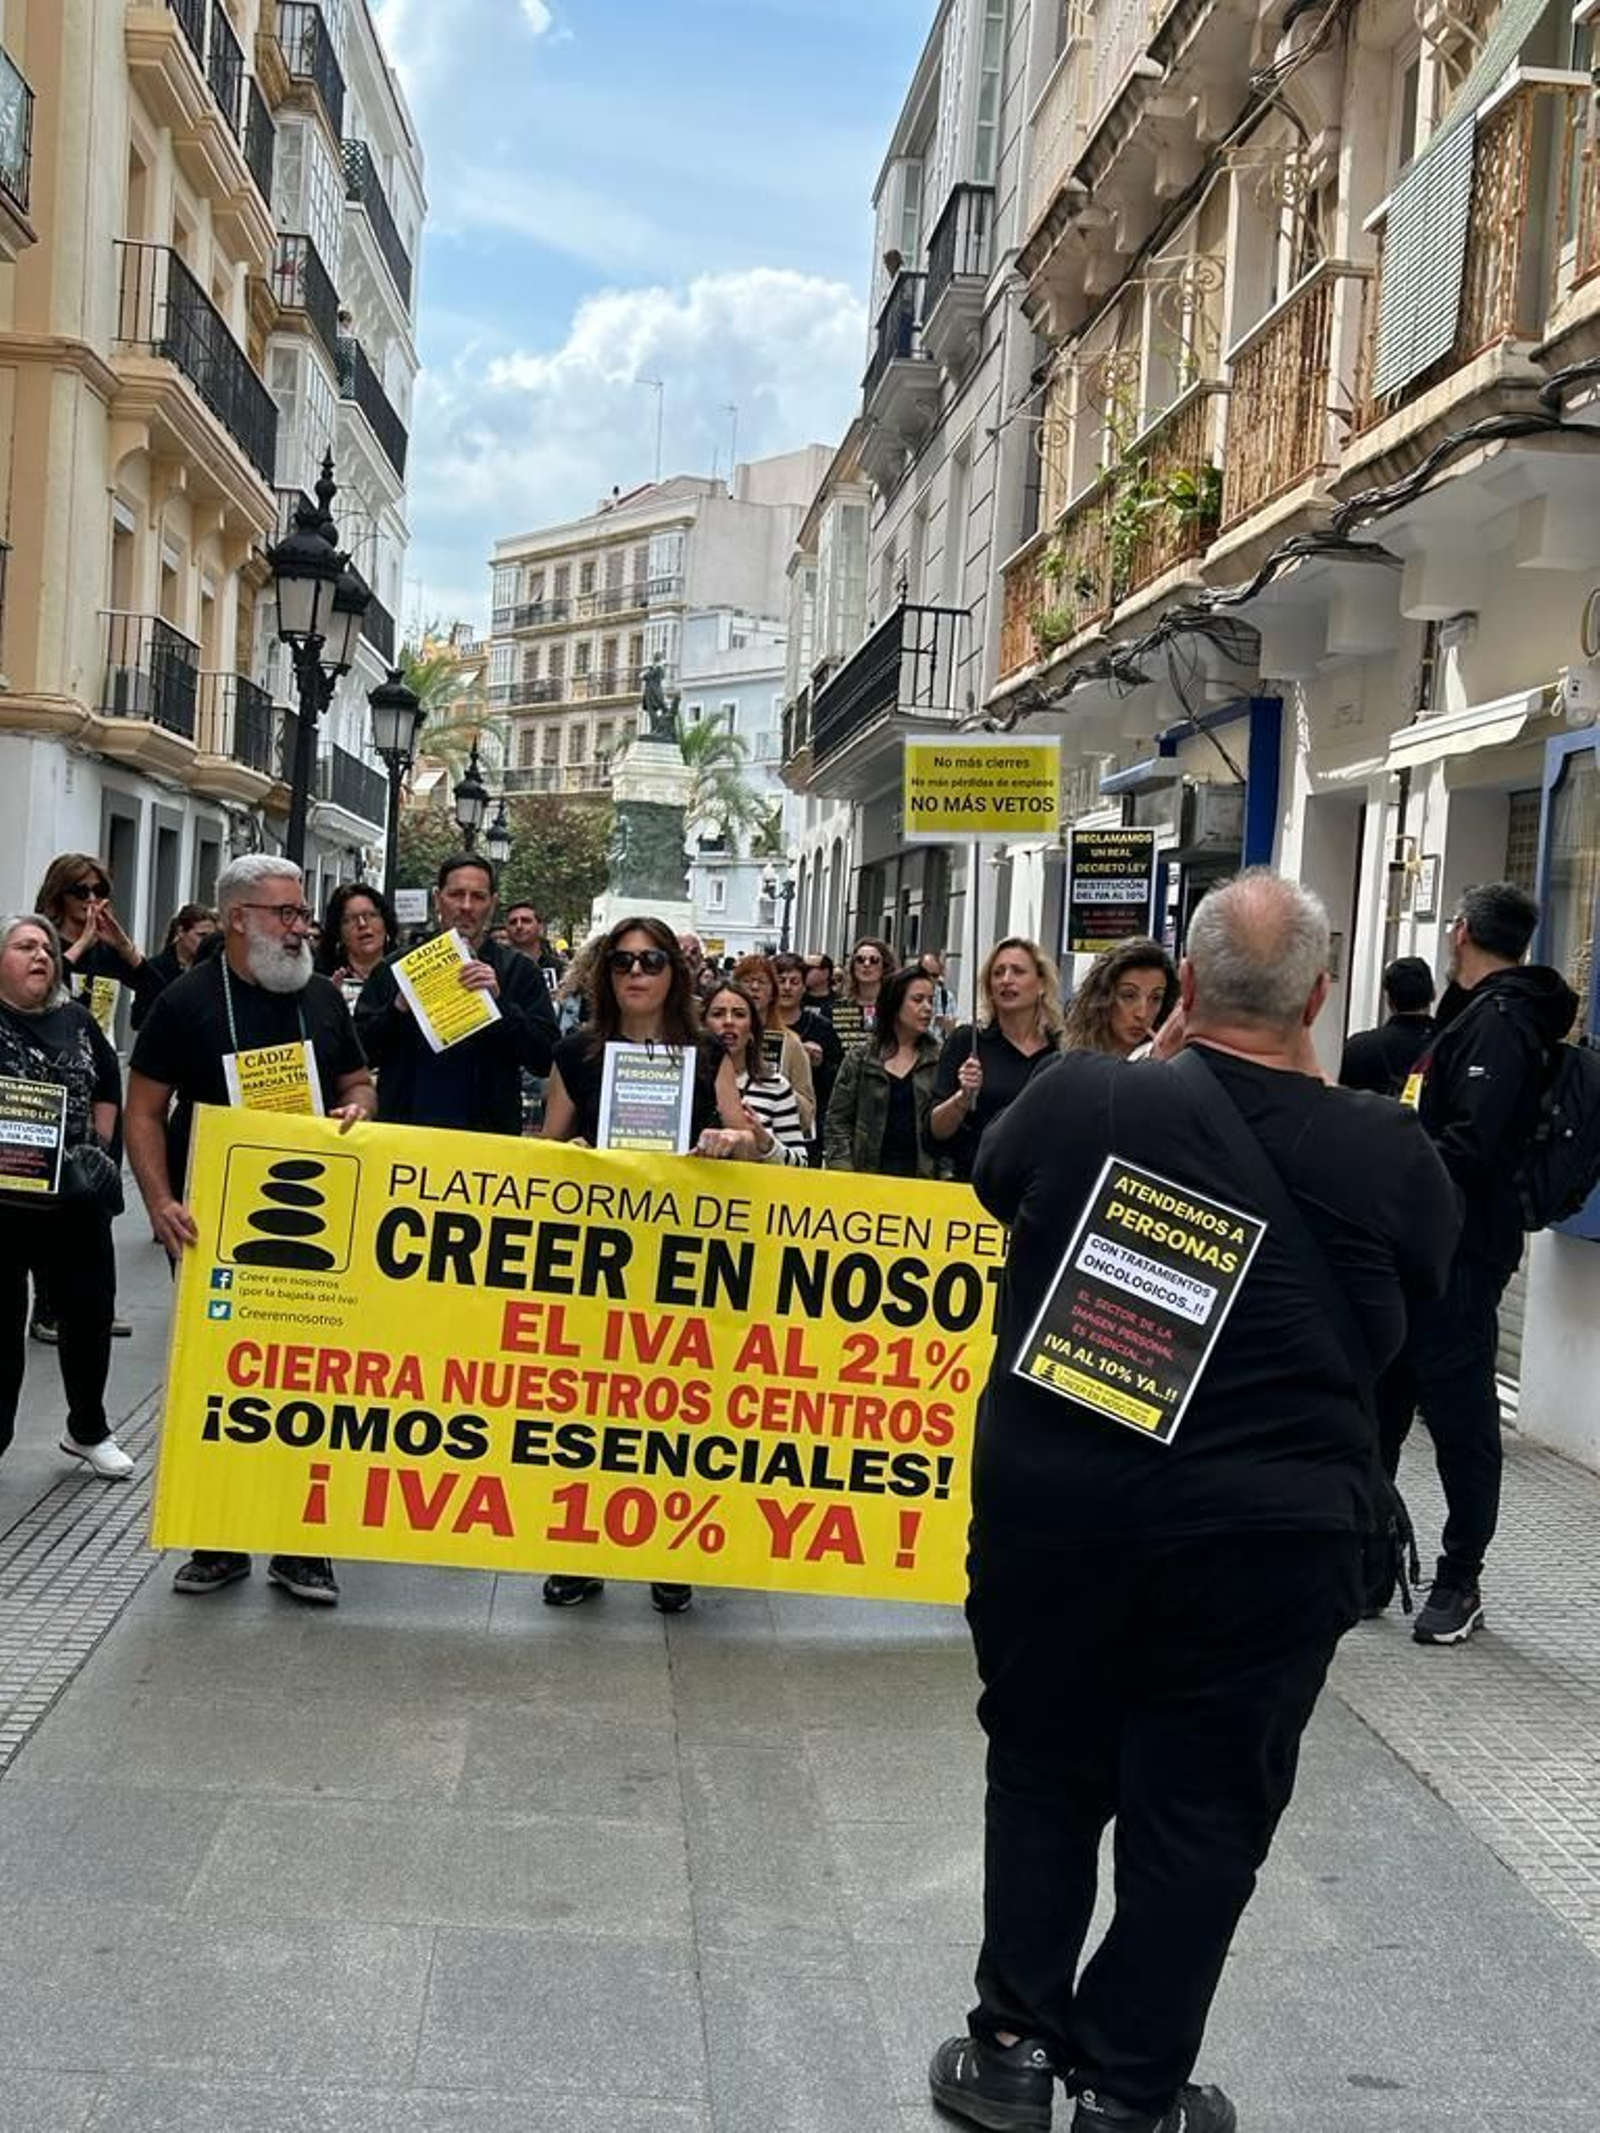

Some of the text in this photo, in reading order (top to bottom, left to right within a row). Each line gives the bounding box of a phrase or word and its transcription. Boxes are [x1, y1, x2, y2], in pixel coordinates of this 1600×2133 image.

[933, 756, 1030, 769] No más cierres
[911, 777, 1055, 789] No más pérdidas de empleos
[911, 793, 1055, 813] NO MÁS VETOS
[1075, 833, 1152, 844] RECLAMAMOS
[1090, 848, 1133, 857] UN REAL
[1075, 863, 1148, 873] DECRETO LEY
[1076, 880, 1145, 890] RESTITUCIÓN
[1076, 891, 1146, 900] DEL IVA AL 10%
[244, 1048, 297, 1069] CÁDIZ
[242, 1071, 309, 1090] MARCHA 11h
[617, 1068, 680, 1081] PERSONAS
[388, 1163, 681, 1226] PLATAFORMA
[692, 1195, 752, 1233] DE
[766, 1202, 932, 1250] IMAGEN
[1113, 1175, 1245, 1244] ATENDEMOS A
[1105, 1200, 1239, 1274] PERSONAS
[375, 1206, 634, 1300] CREER
[655, 1233, 755, 1313] EN
[1090, 1238, 1212, 1299] CON TRATAMIENTOS
[238, 1271, 340, 1290] Creer en nosotros
[238, 1286, 262, 1298] (por
[265, 1286, 275, 1298] la
[277, 1288, 315, 1303] bajada
[317, 1292, 336, 1304] del
[238, 1306, 344, 1327] Creerennosotros
[1077, 1289, 1174, 1340] EL SECTOR DE LA
[1070, 1303, 1176, 1362] IMAGEN PERSONAL
[500, 1300, 972, 1394] EL IVA AL 21%
[1043, 1332, 1072, 1358] IVA
[1073, 1346, 1095, 1367] AL
[1098, 1355, 1133, 1384] 10%
[226, 1340, 956, 1447] CIERRA NUESTROS CENTROS
[202, 1394, 956, 1500] ¡SOMOS ESENCIALES!
[361, 1465, 516, 1538] IVA
[546, 1480, 726, 1555] 10%
[755, 1497, 866, 1566] YA
[894, 1508, 924, 1570] !
